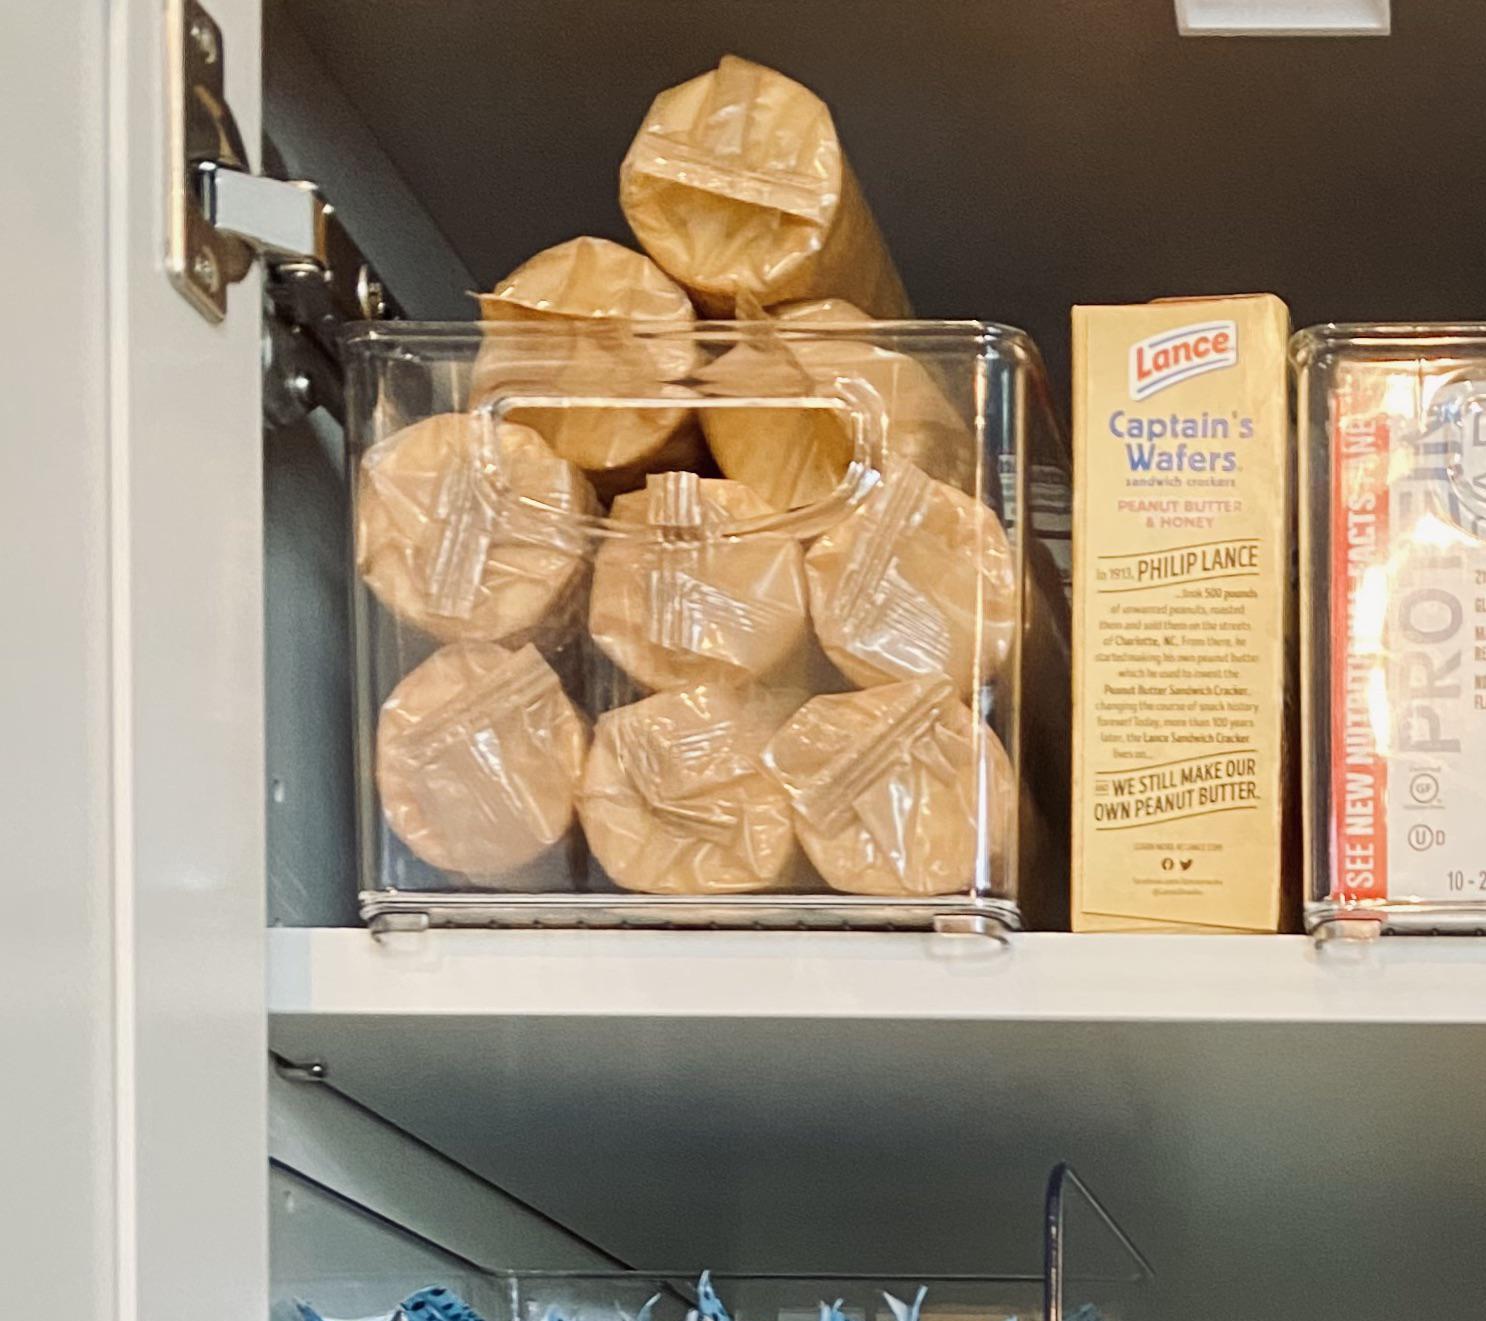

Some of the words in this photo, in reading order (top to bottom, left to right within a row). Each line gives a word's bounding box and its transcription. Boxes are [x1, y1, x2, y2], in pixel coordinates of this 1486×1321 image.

[1137, 332, 1230, 382] Lance
[1109, 411, 1254, 441] Captain's
[1126, 443, 1238, 472] Wafers
[1118, 501, 1179, 512] PEANUT
[1184, 501, 1242, 512] BUTTER
[1146, 517, 1153, 528] &
[1160, 517, 1215, 528] HONEY
[1138, 552, 1197, 582] PHILIP
[1202, 546, 1258, 572] LANCE
[1113, 780, 1135, 796] WE
[1139, 773, 1177, 794] STILL
[1181, 764, 1222, 785] MAKE
[1226, 759, 1255, 777] OUR
[1095, 802, 1130, 821] OWN
[1135, 791, 1194, 817] PEANUT
